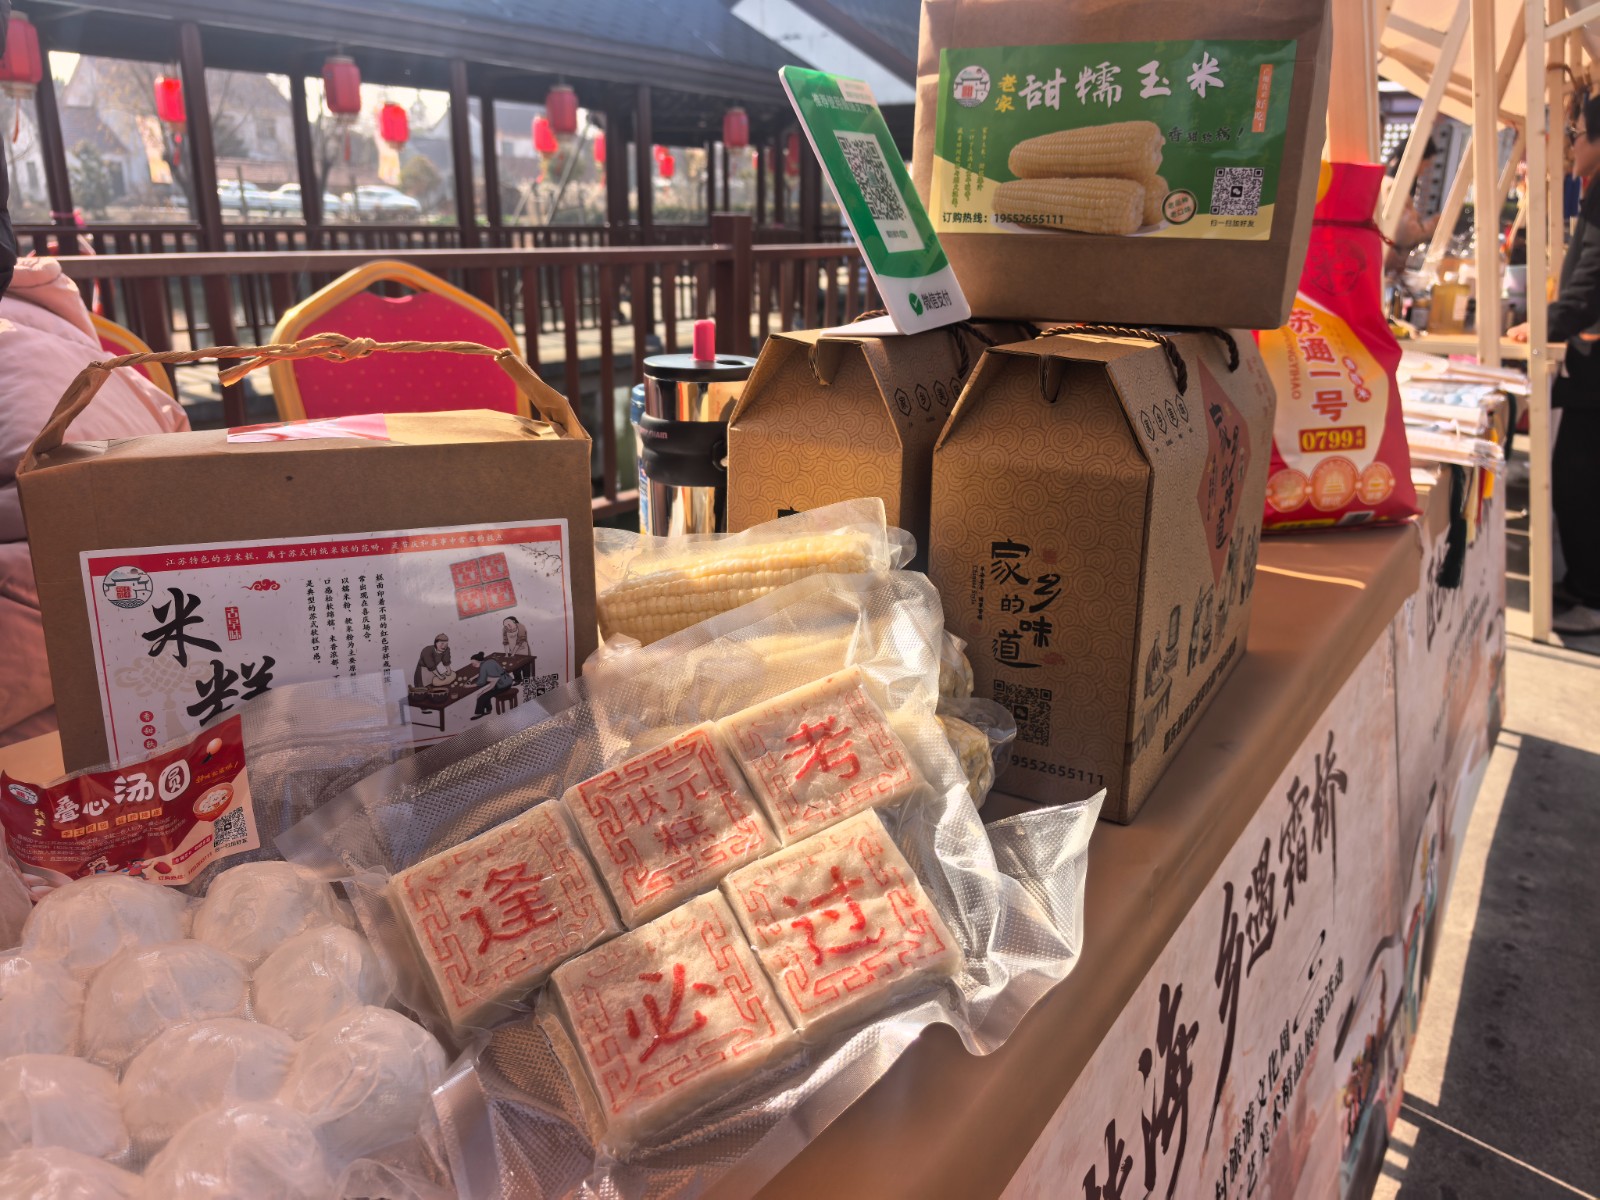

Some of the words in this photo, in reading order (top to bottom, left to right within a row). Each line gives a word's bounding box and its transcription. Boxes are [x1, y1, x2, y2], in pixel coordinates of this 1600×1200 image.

[995, 74, 1018, 112] 老家
[1018, 52, 1224, 111] 甜糯玉米
[995, 213, 1064, 225] 19552655111
[922, 290, 952, 311] 微信支付
[1302, 431, 1353, 451] 0799
[226, 607, 242, 641] 古早味
[785, 715, 862, 781] 考
[460, 862, 561, 953] 逢
[783, 866, 885, 964] 过
[626, 963, 718, 1062] 必
